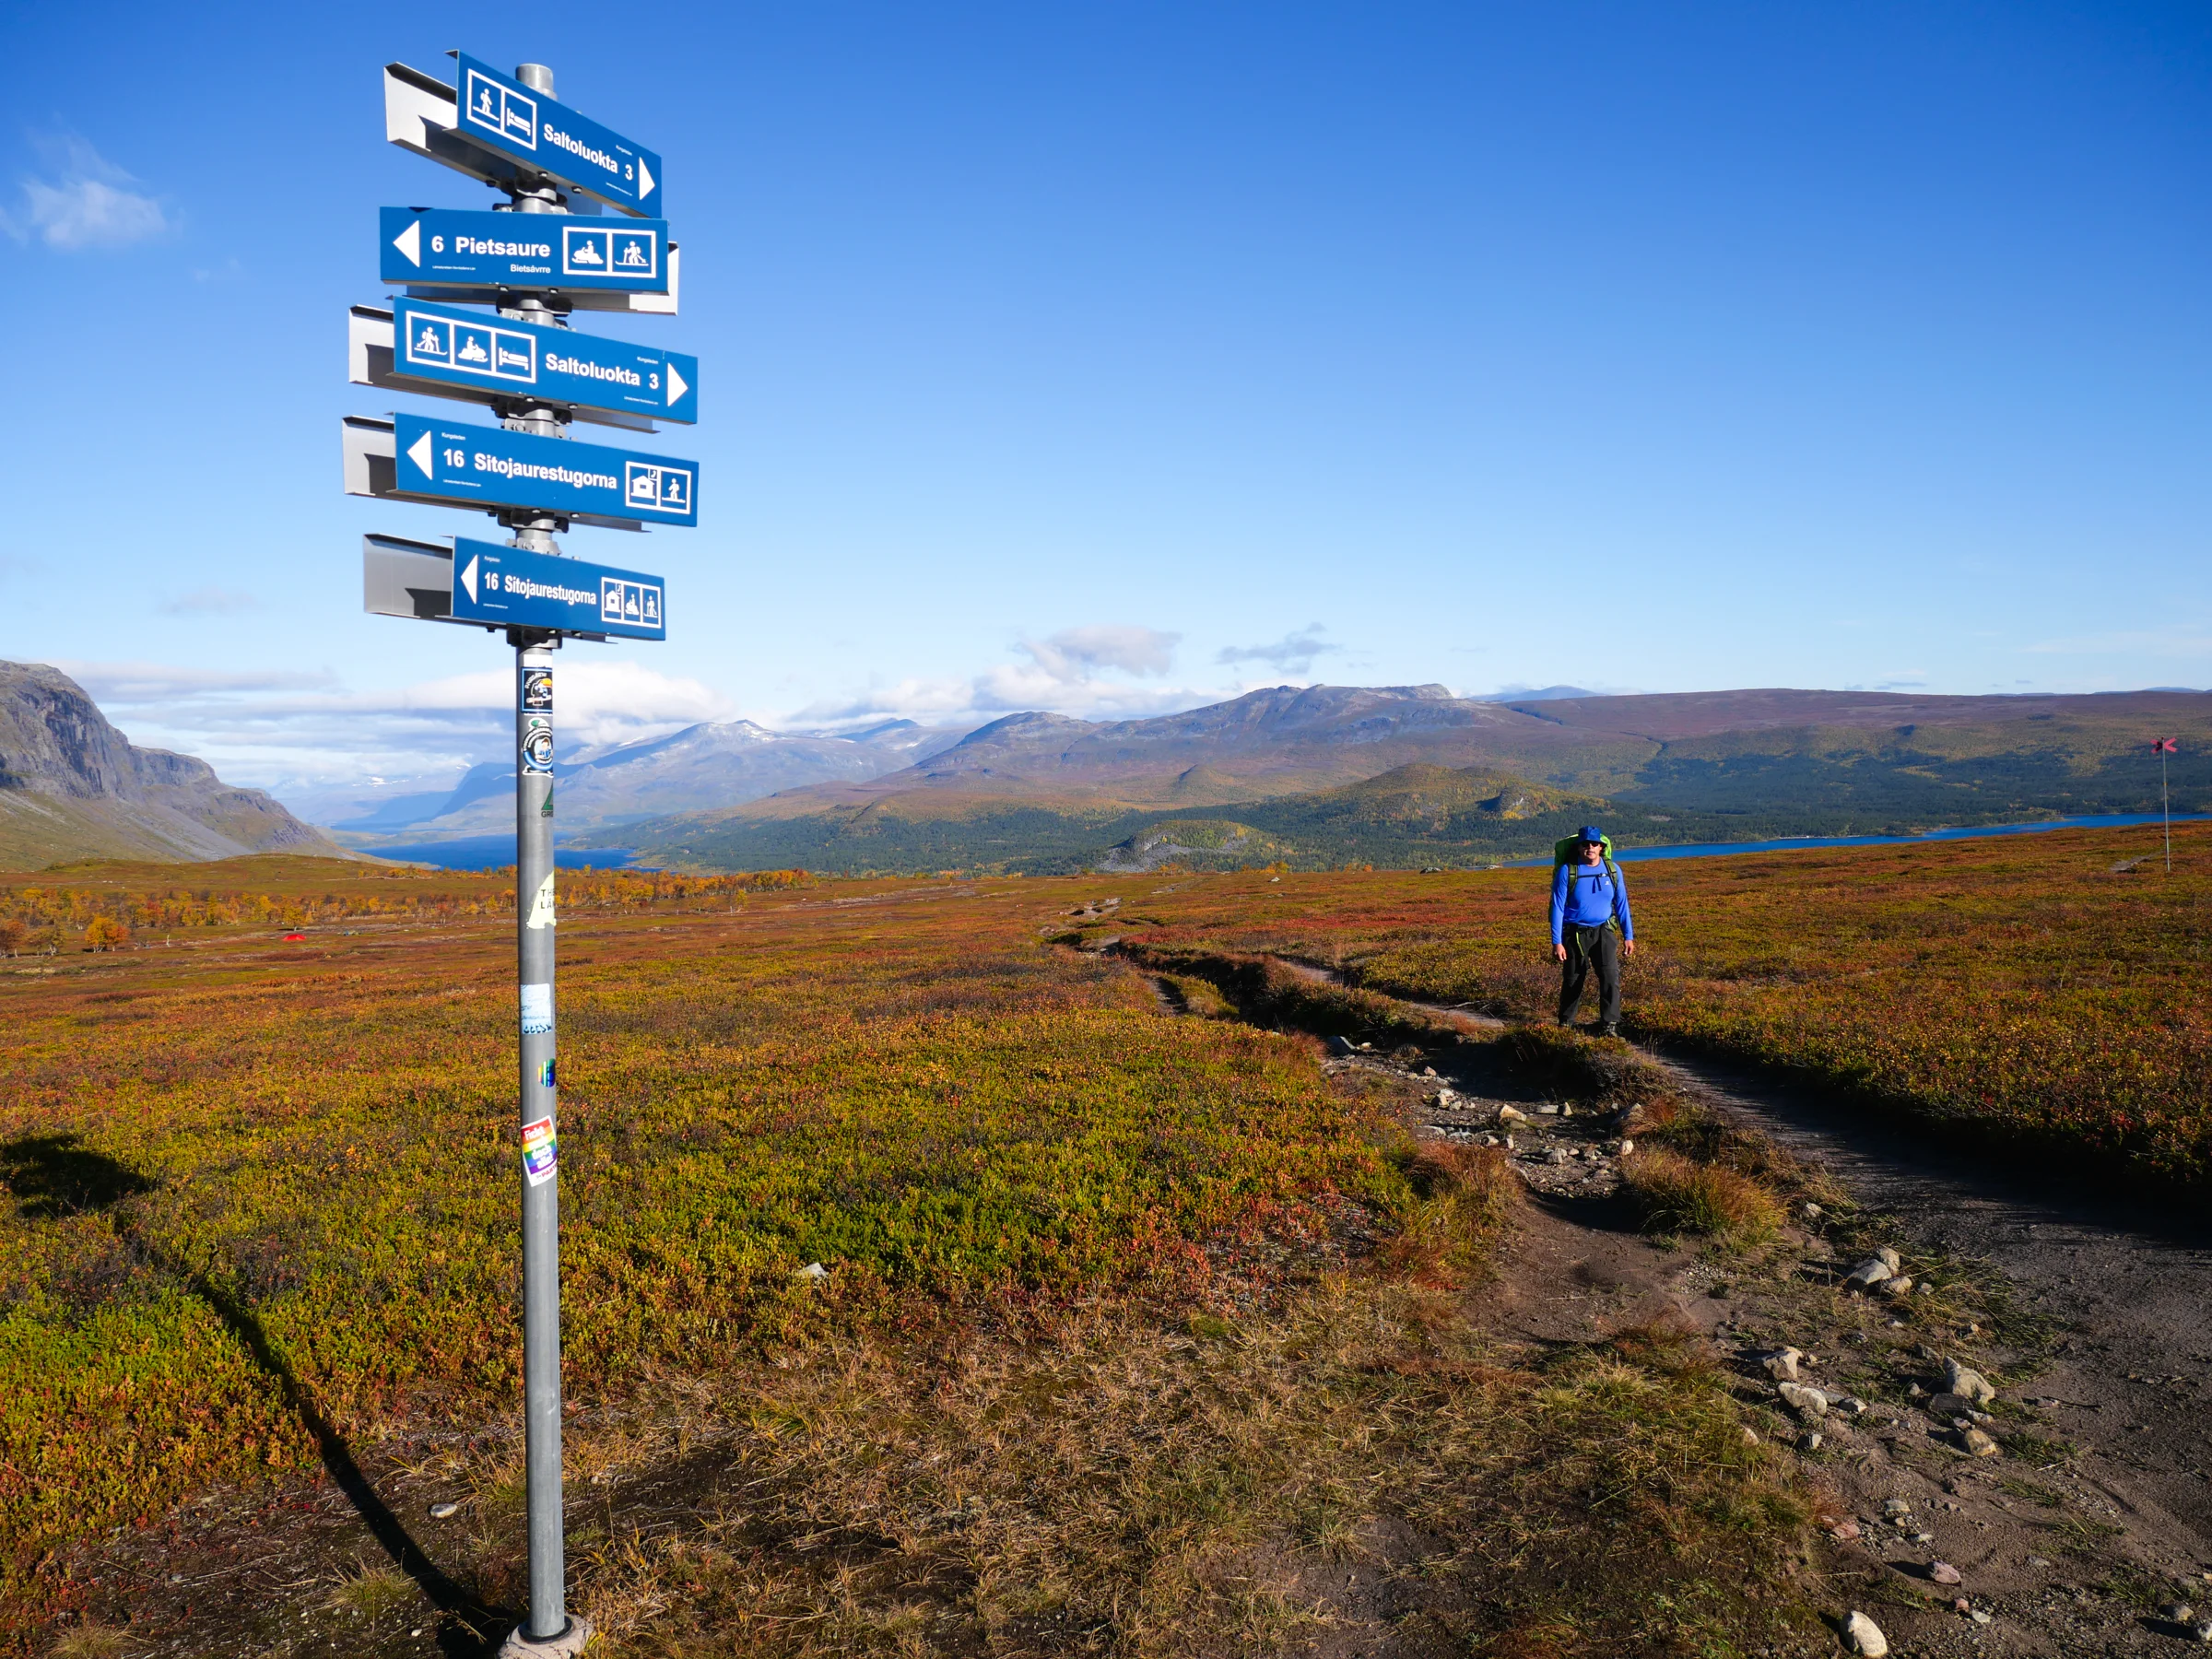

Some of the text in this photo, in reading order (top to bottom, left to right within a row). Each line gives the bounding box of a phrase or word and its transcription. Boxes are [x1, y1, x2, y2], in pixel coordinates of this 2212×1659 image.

[544, 124, 633, 181] Saltoluokta 3
[431, 235, 550, 257] 6 Pietsaure
[546, 353, 659, 389] Saltoluokta 3
[443, 448, 618, 489] 16 Sitojaurestugorna
[484, 571, 597, 606] 16 Sitojaurestugorna
